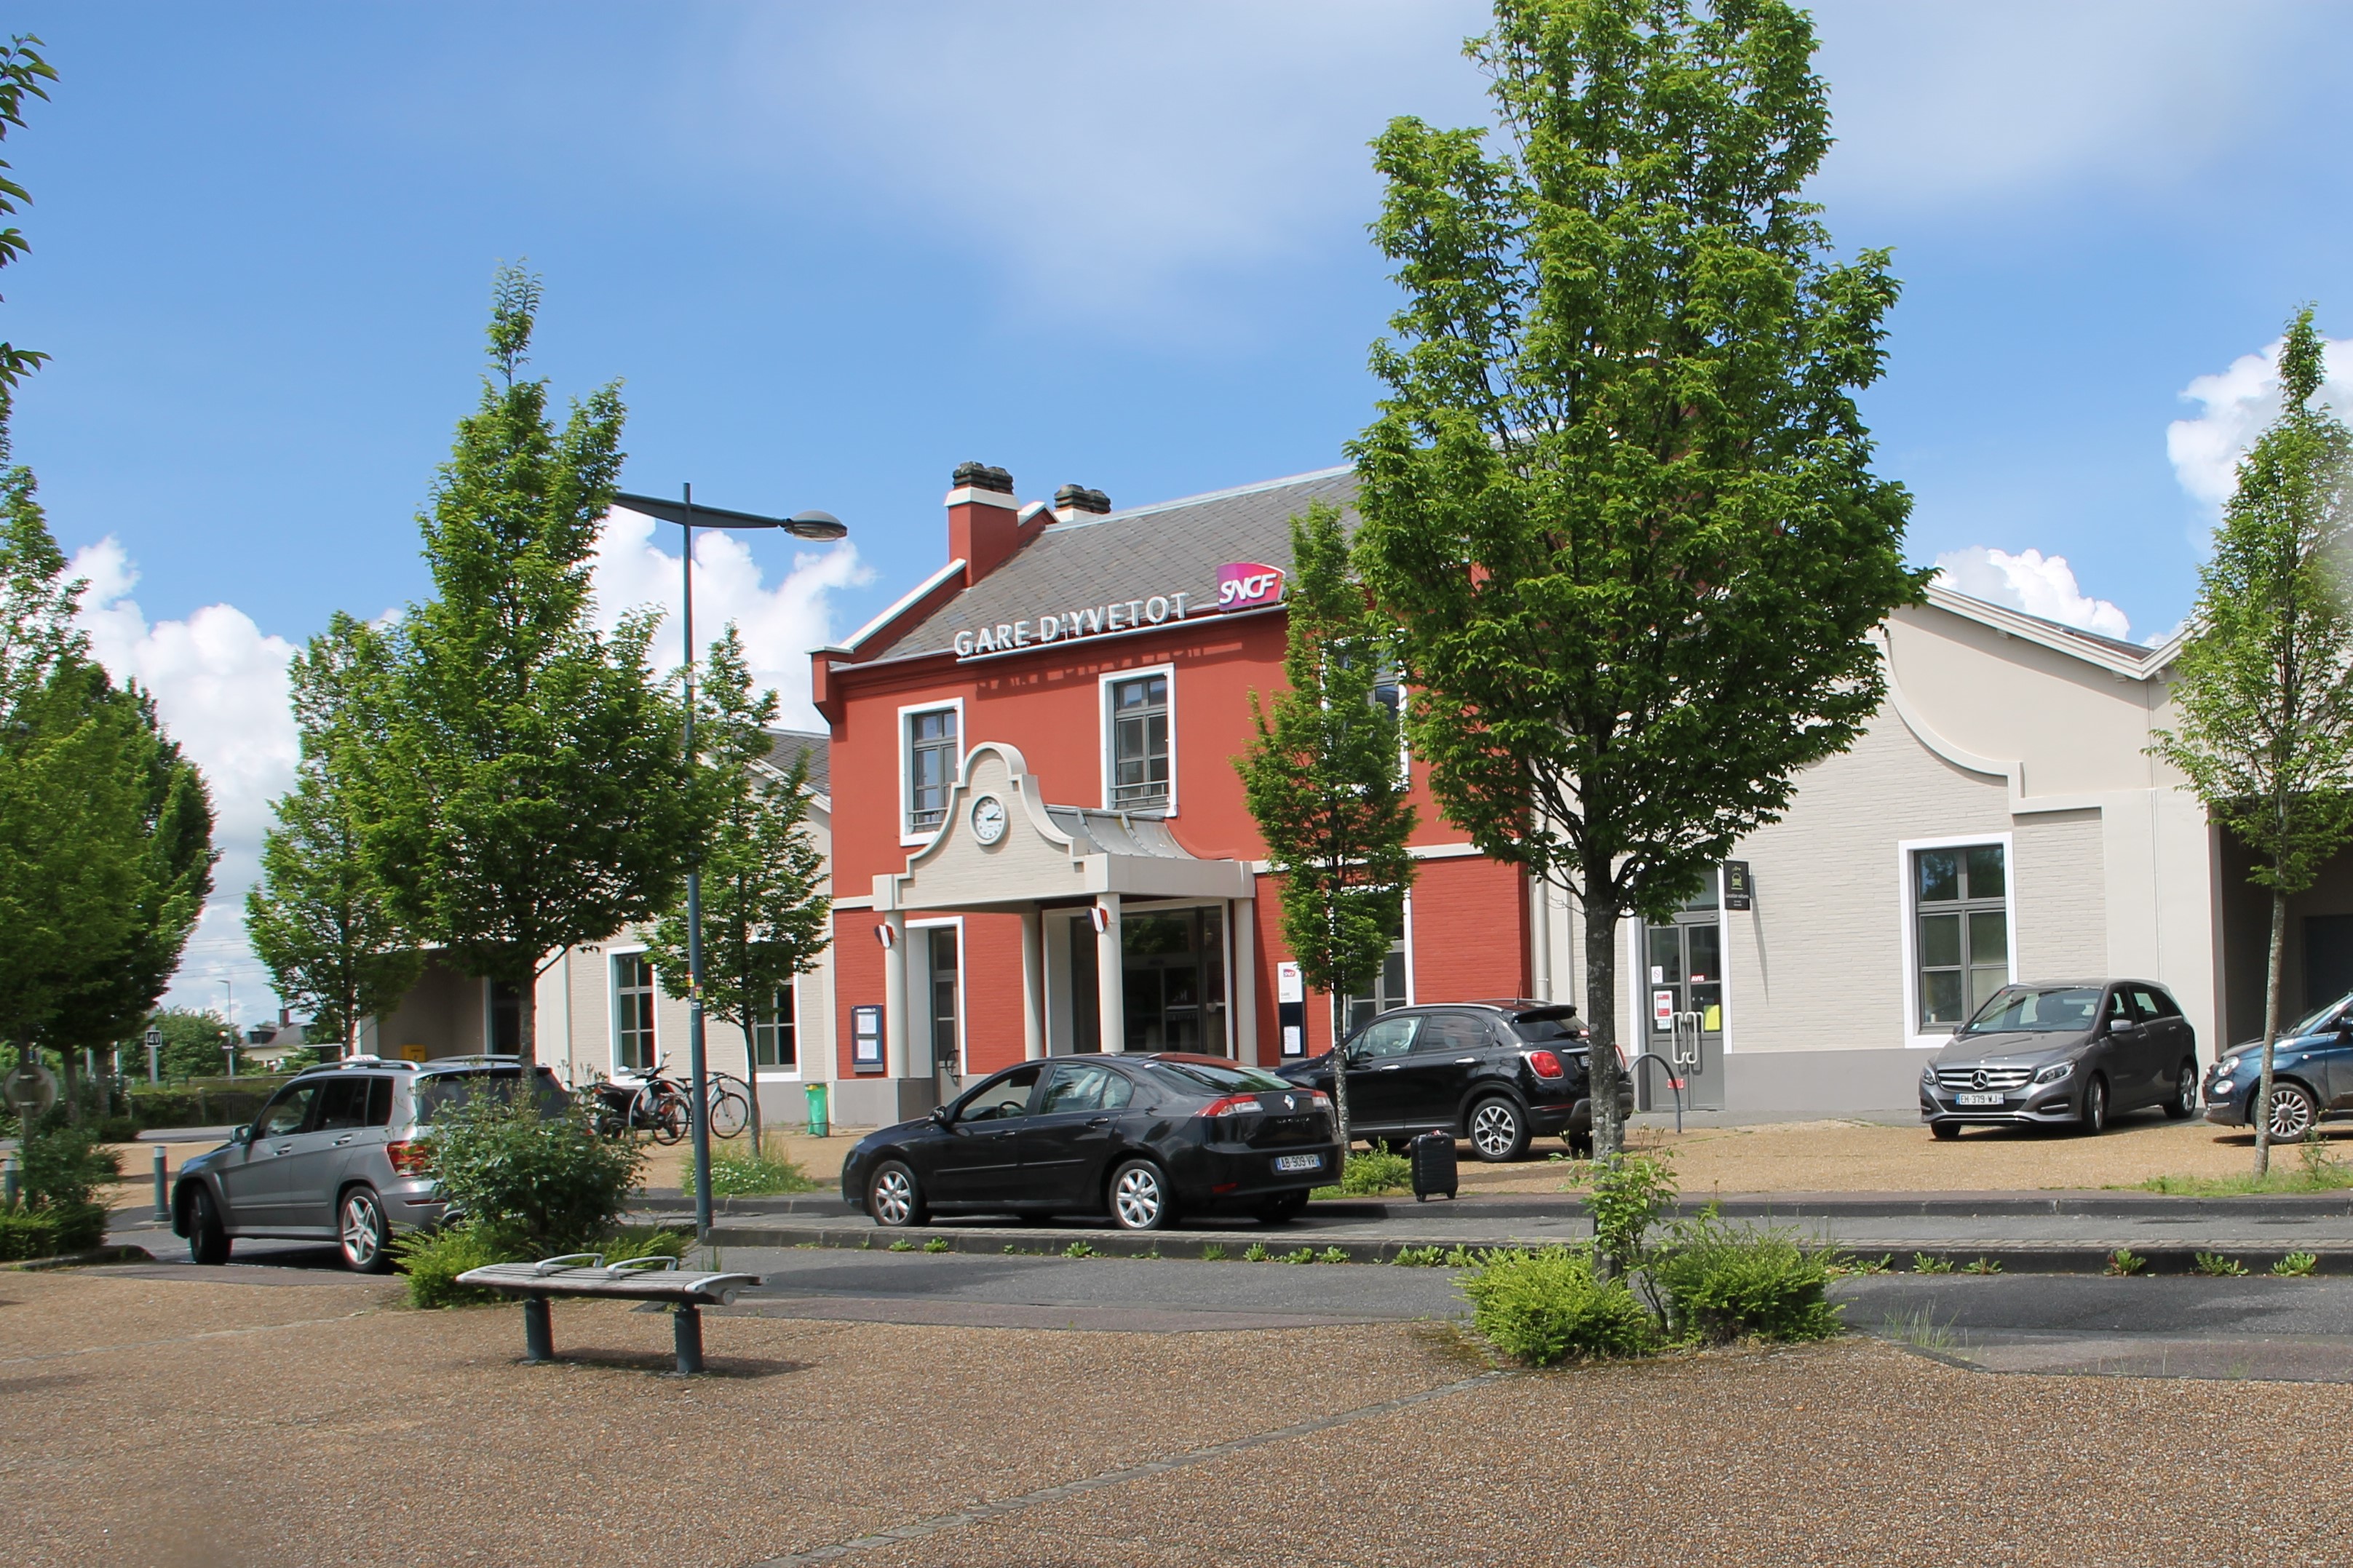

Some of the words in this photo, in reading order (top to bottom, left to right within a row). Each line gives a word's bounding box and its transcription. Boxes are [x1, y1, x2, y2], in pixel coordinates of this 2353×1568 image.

[1219, 573, 1277, 604] SNCF
[954, 620, 1031, 656] GARE
[1041, 592, 1189, 642] D'YVETOT
